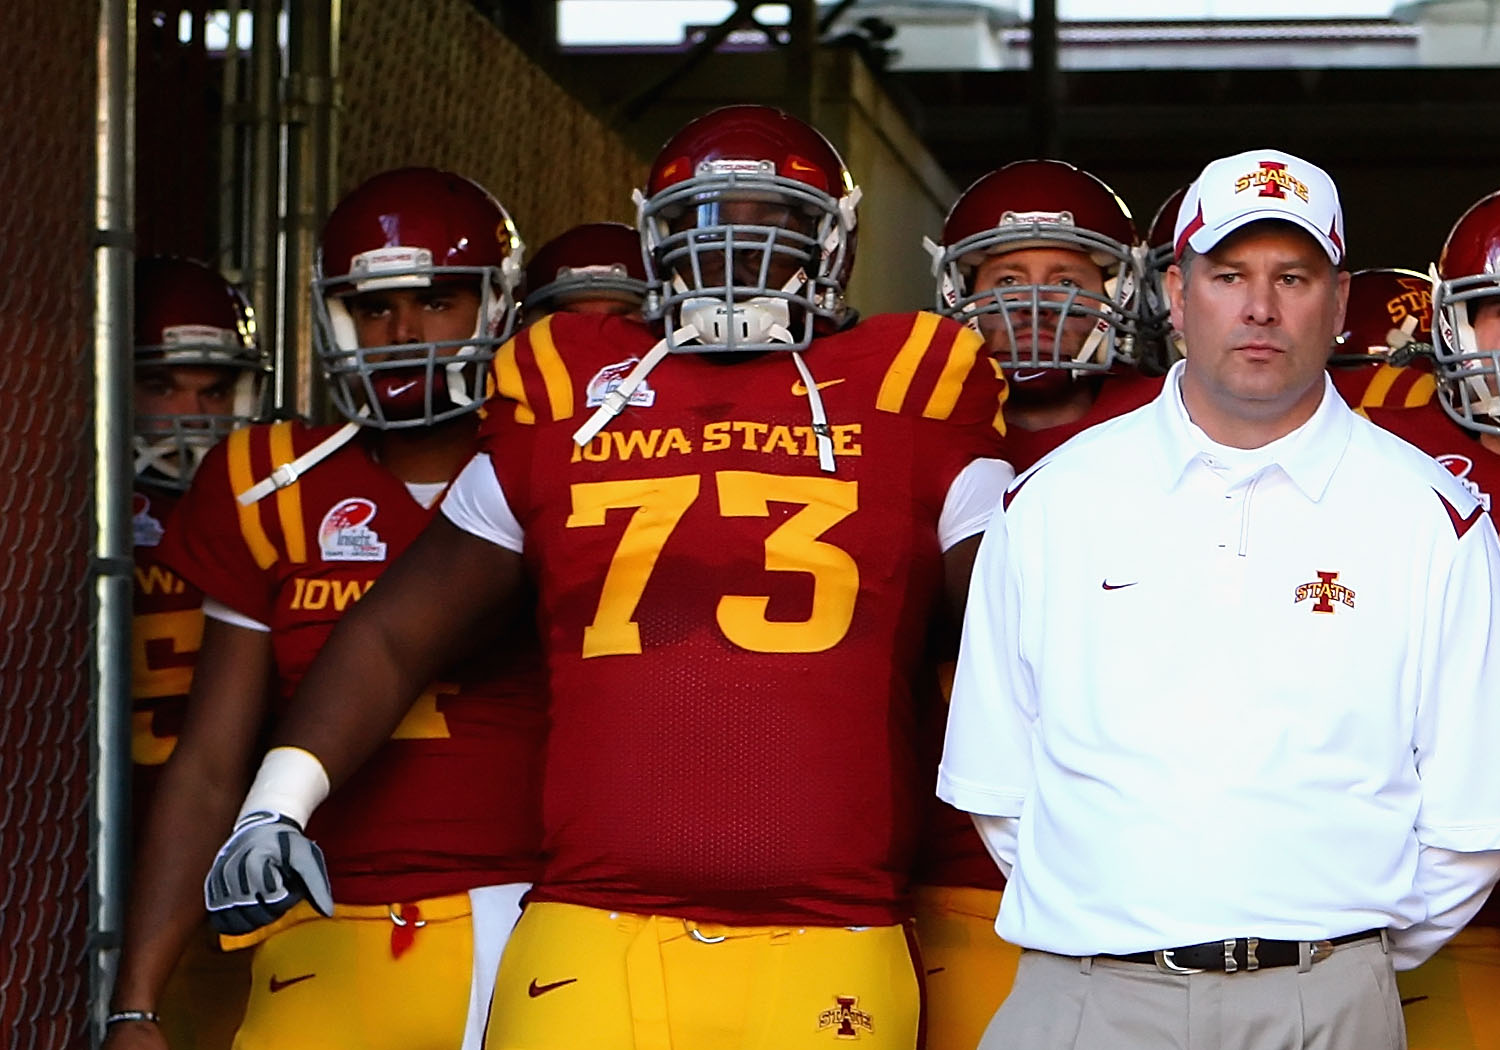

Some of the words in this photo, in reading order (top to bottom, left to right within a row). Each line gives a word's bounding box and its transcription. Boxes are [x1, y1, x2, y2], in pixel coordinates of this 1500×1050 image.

[1234, 168, 1309, 204] STATE
[702, 420, 862, 457] STATE
[565, 470, 860, 659] 73
[1294, 581, 1356, 608] STATE
[818, 1008, 873, 1031] STATE
